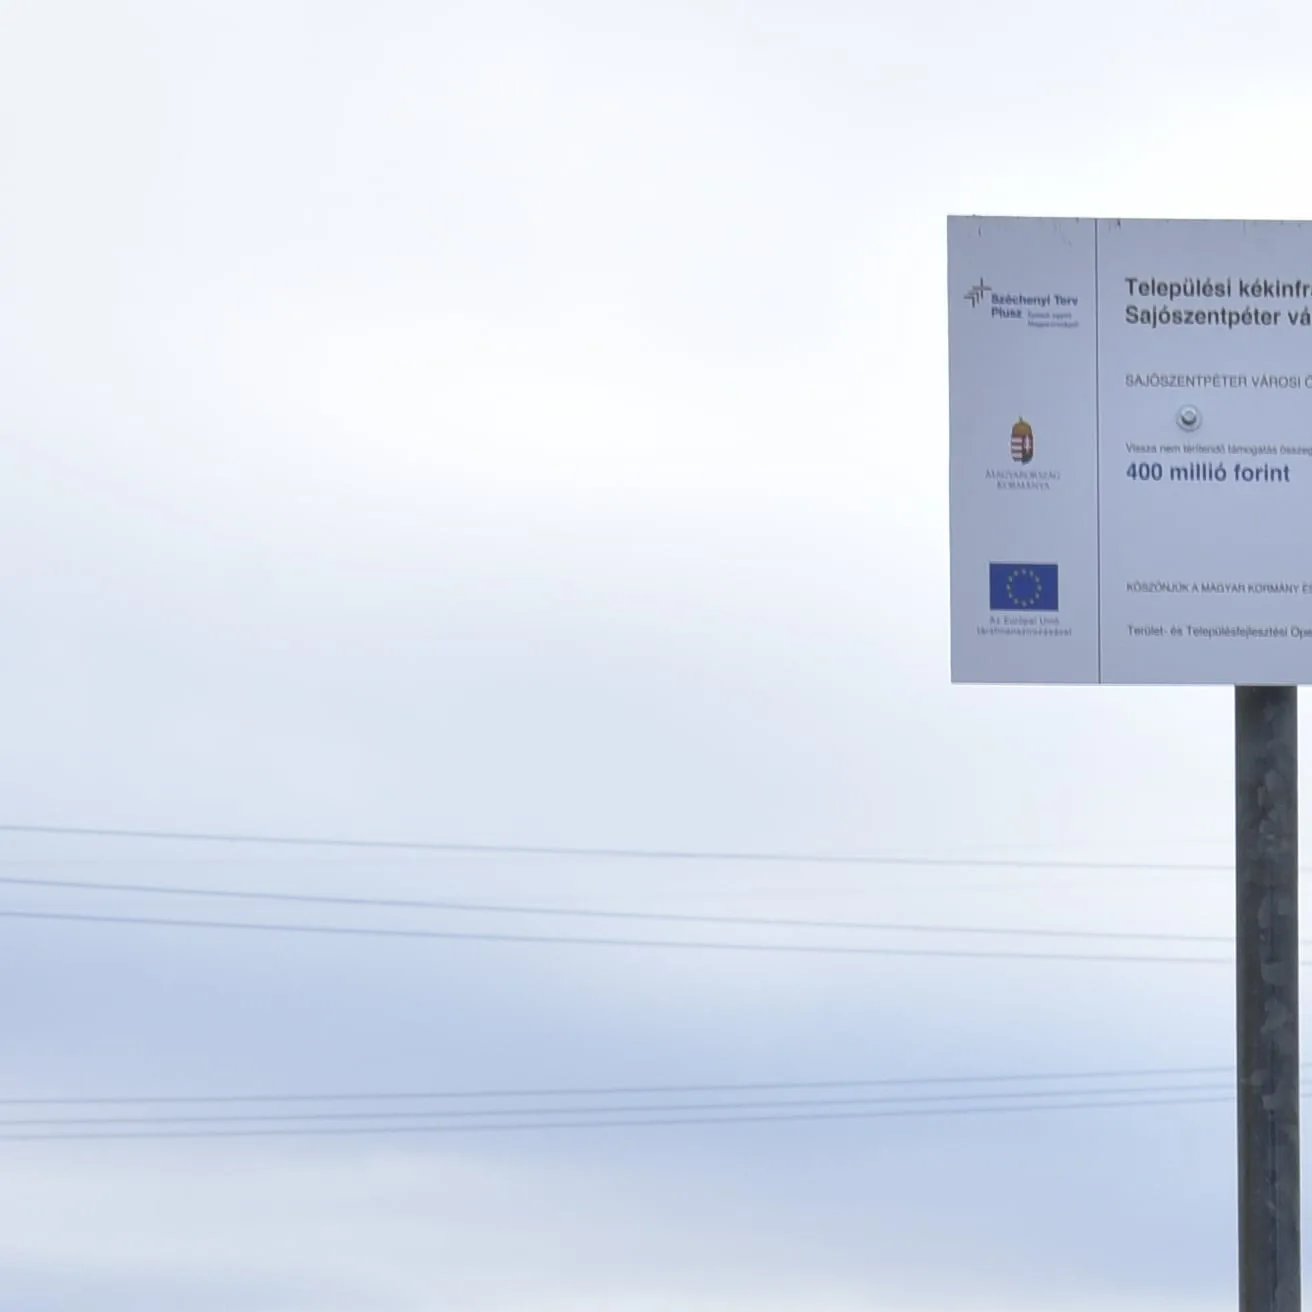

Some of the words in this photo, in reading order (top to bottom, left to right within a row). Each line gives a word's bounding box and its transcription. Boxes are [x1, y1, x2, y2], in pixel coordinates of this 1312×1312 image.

[1125, 277, 1231, 301] Települési
[1125, 304, 1281, 329] Sajószentpéter
[1125, 373, 1247, 388] SAJÓSZENTPÉTER
[1251, 374, 1300, 389] VÁROSI
[1126, 462, 1163, 481] 400
[1169, 462, 1227, 482] millió
[1234, 463, 1290, 482] forint
